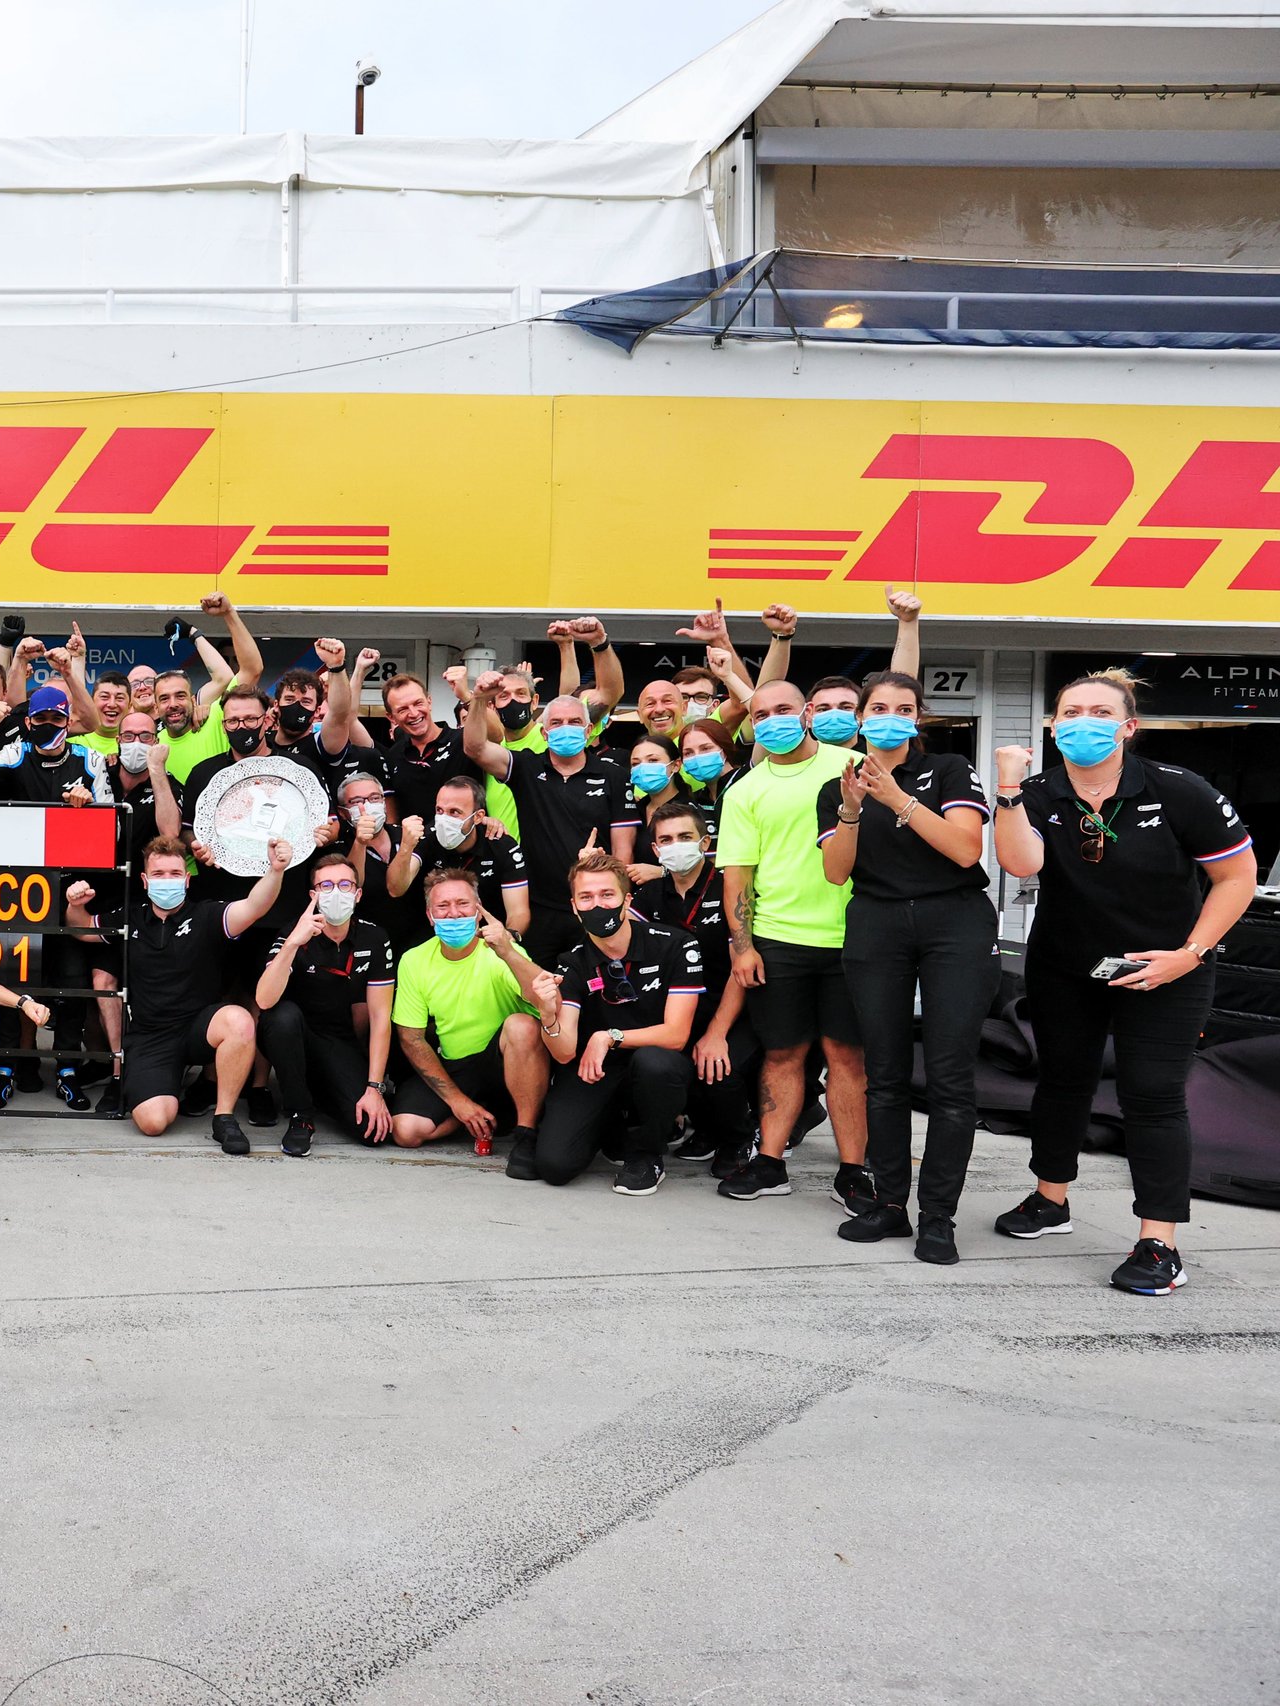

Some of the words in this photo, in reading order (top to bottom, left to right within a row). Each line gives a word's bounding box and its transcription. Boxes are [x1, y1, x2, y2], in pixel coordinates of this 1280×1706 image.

[364, 662, 397, 681] 28
[933, 672, 968, 692] 27
[1240, 687, 1278, 697] TEAM
